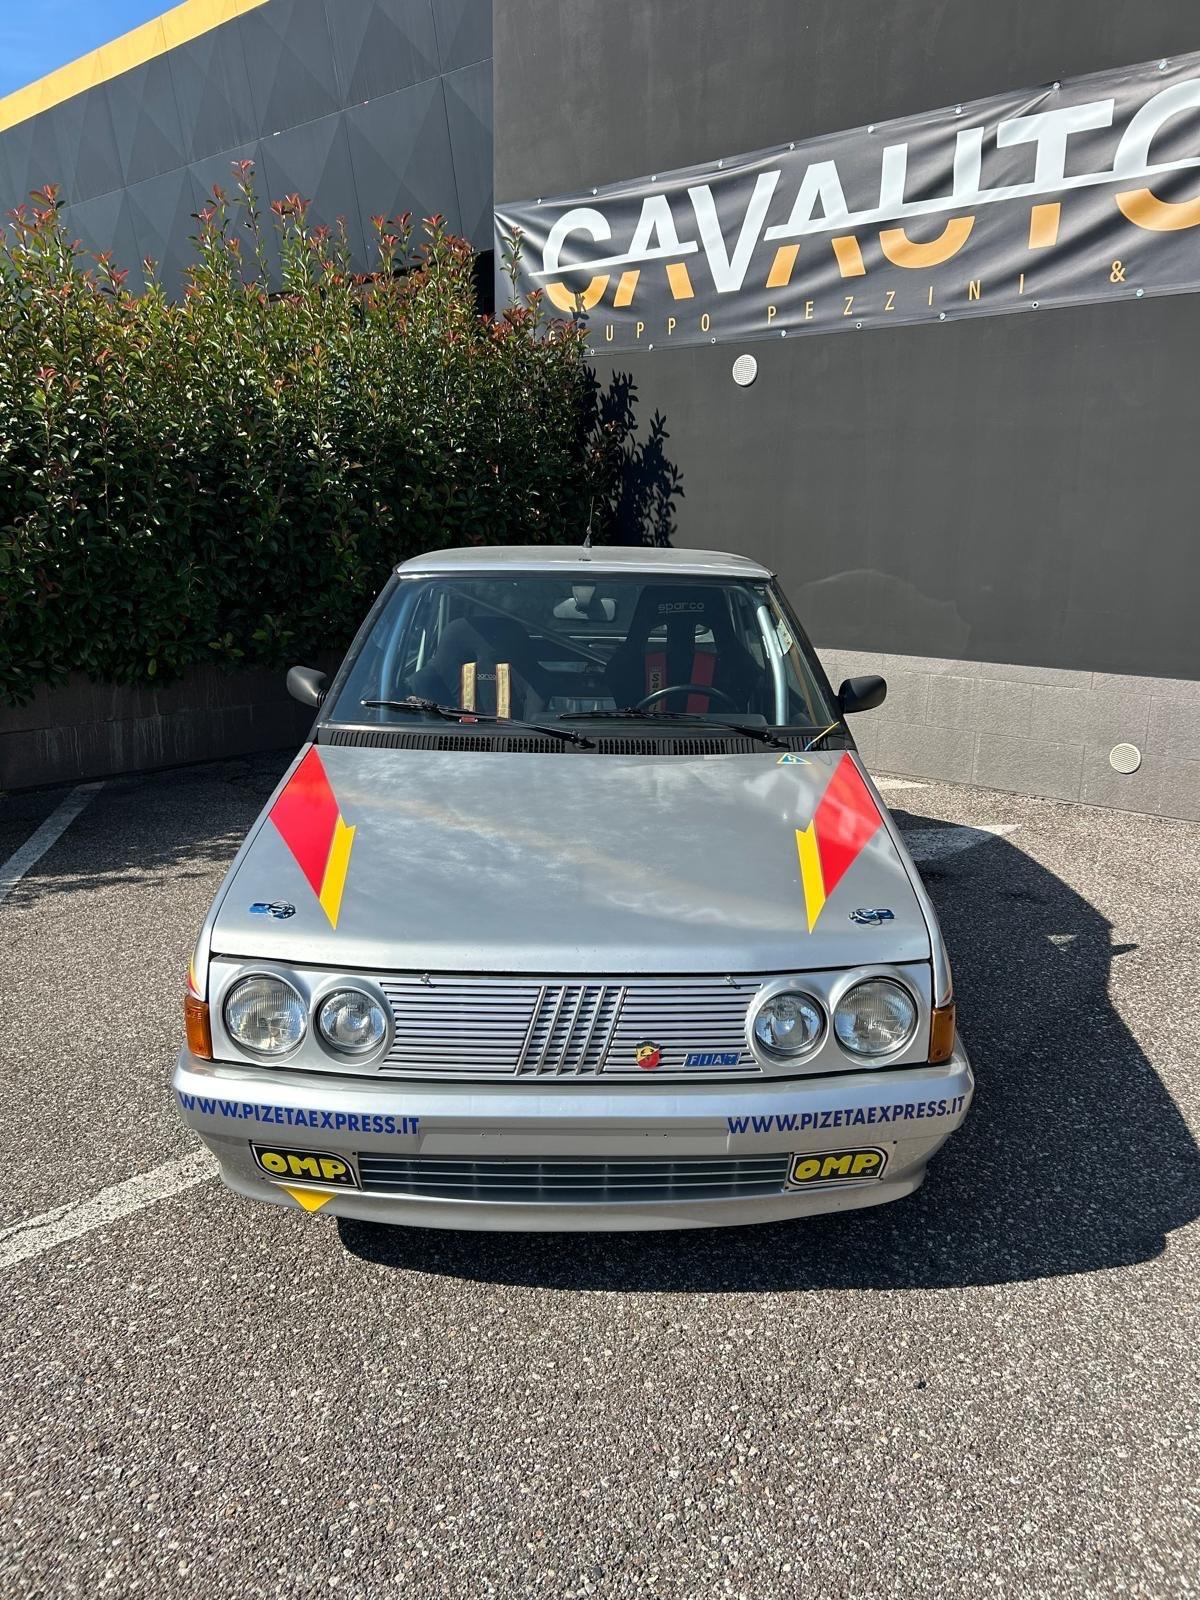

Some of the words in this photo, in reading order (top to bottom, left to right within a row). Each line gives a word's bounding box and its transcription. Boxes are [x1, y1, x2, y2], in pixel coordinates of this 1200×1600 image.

[767, 273, 1024, 325] PEZZINI
[1110, 260, 1127, 284] &
[657, 602, 705, 616] sparco
[689, 1054, 736, 1066] FIAT
[178, 1091, 420, 1134] WWW.PIZETAEXPRESS.IT
[728, 1096, 966, 1134] WWW.PIZETAEXPRESS.IT
[261, 1152, 346, 1179] OMP
[794, 1153, 880, 1180] OMP
